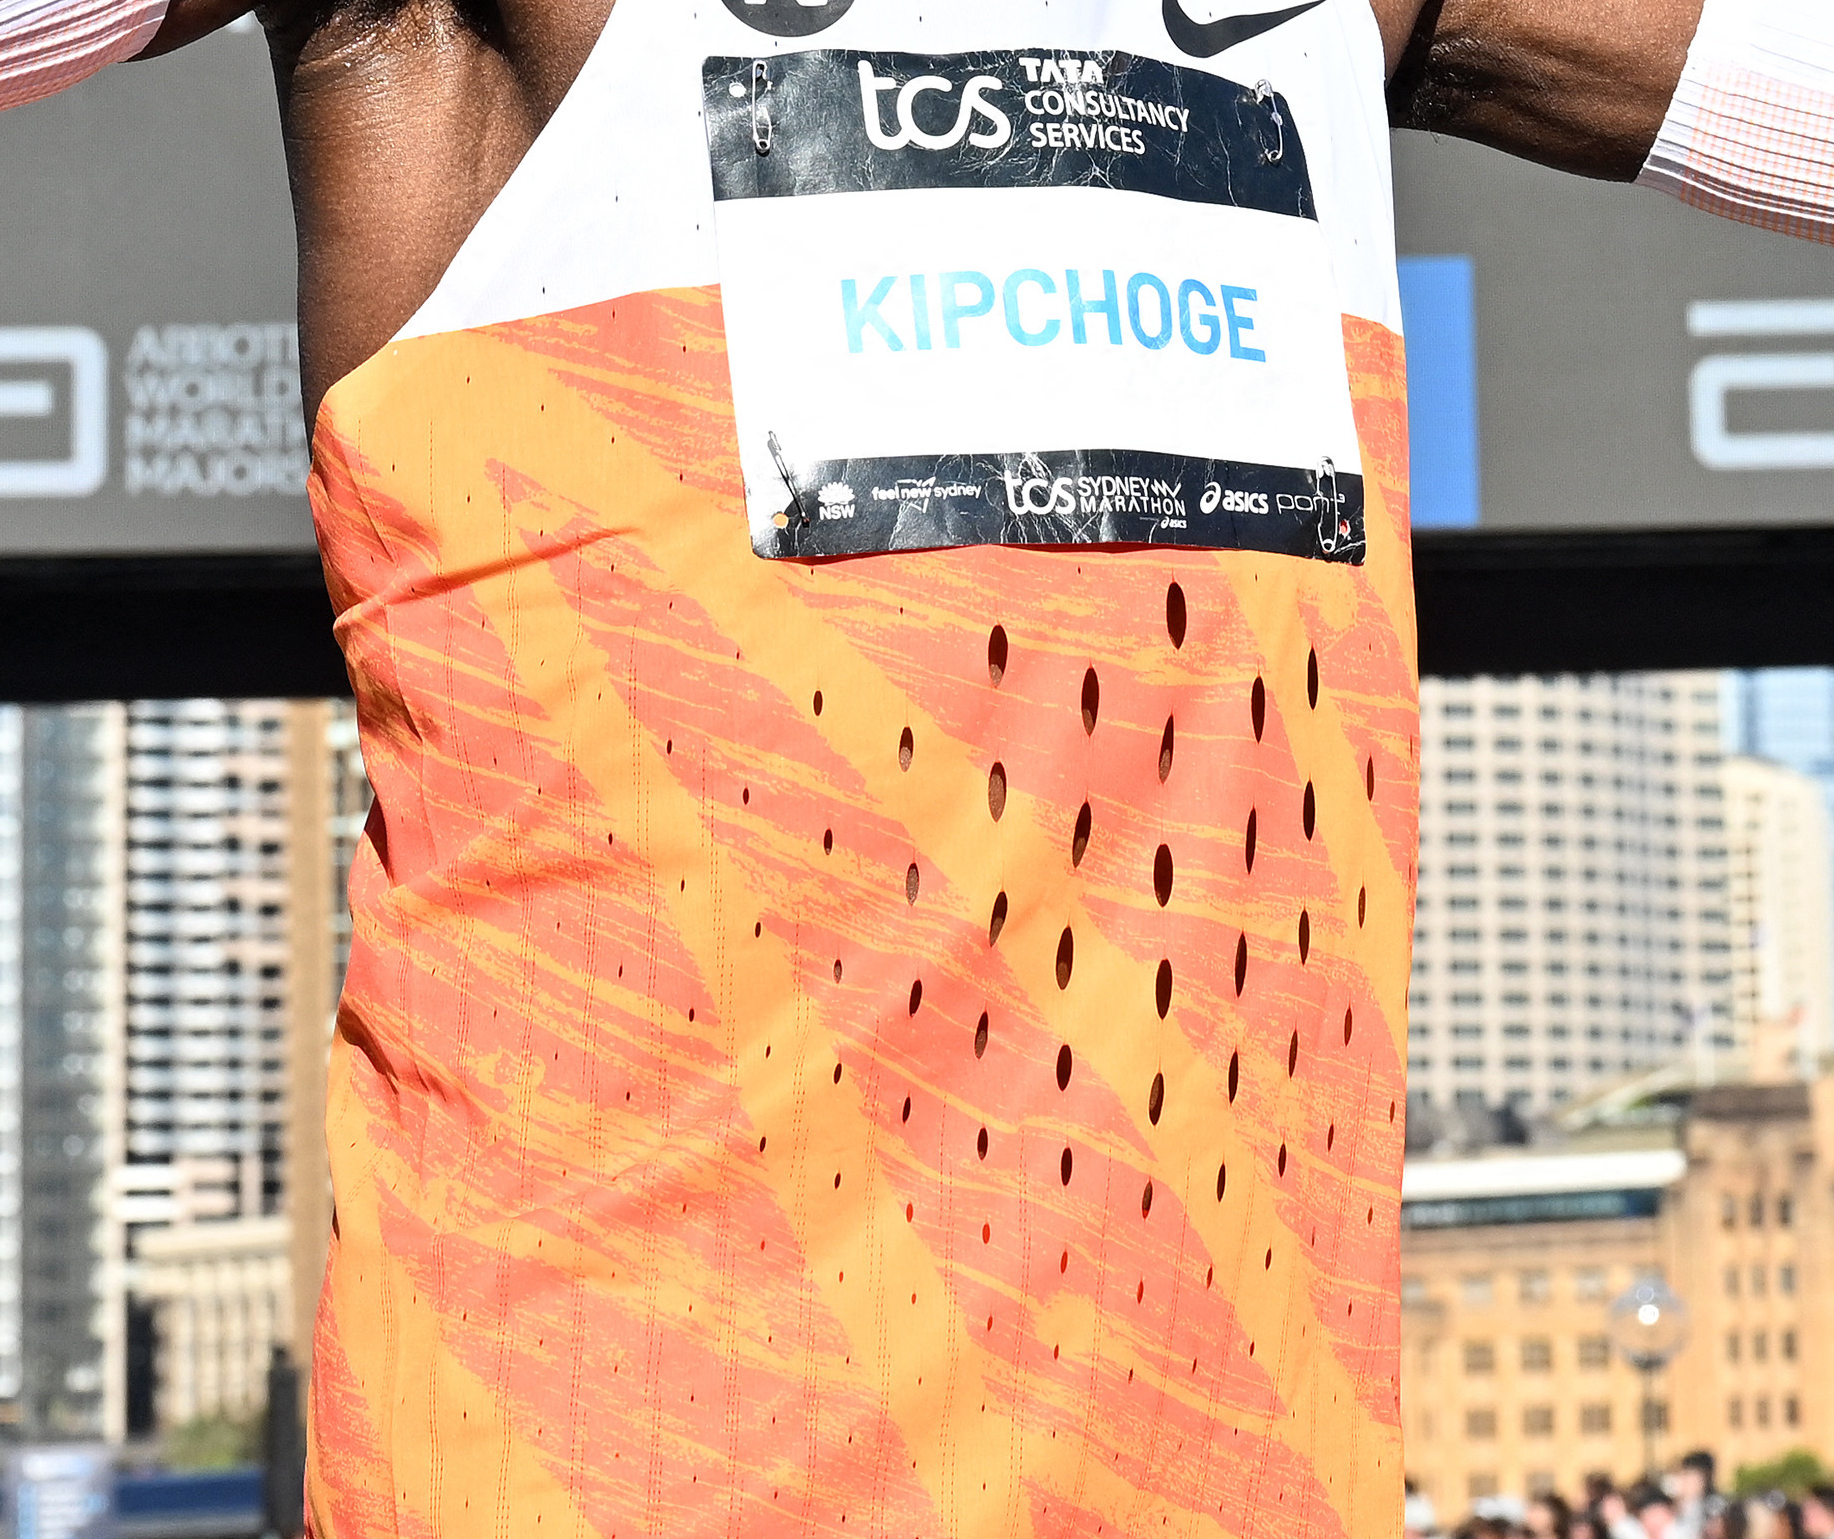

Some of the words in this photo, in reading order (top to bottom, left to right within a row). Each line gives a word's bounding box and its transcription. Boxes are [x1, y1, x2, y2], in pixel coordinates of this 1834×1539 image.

[1019, 57, 1105, 84] TATA
[857, 58, 1014, 151] tcs
[1025, 89, 1191, 134] CONSULTANCY
[1030, 121, 1147, 156] SERVICES
[840, 268, 1267, 363] KIPCHOGE
[871, 486, 900, 501] feel
[901, 486, 932, 499] new
[934, 483, 982, 500] sydney
[1004, 469, 1076, 516] tcs
[1078, 476, 1150, 497] SYDNEY
[819, 503, 856, 521] NSW
[1080, 496, 1186, 517] MARATHON
[1222, 491, 1269, 515] asics
